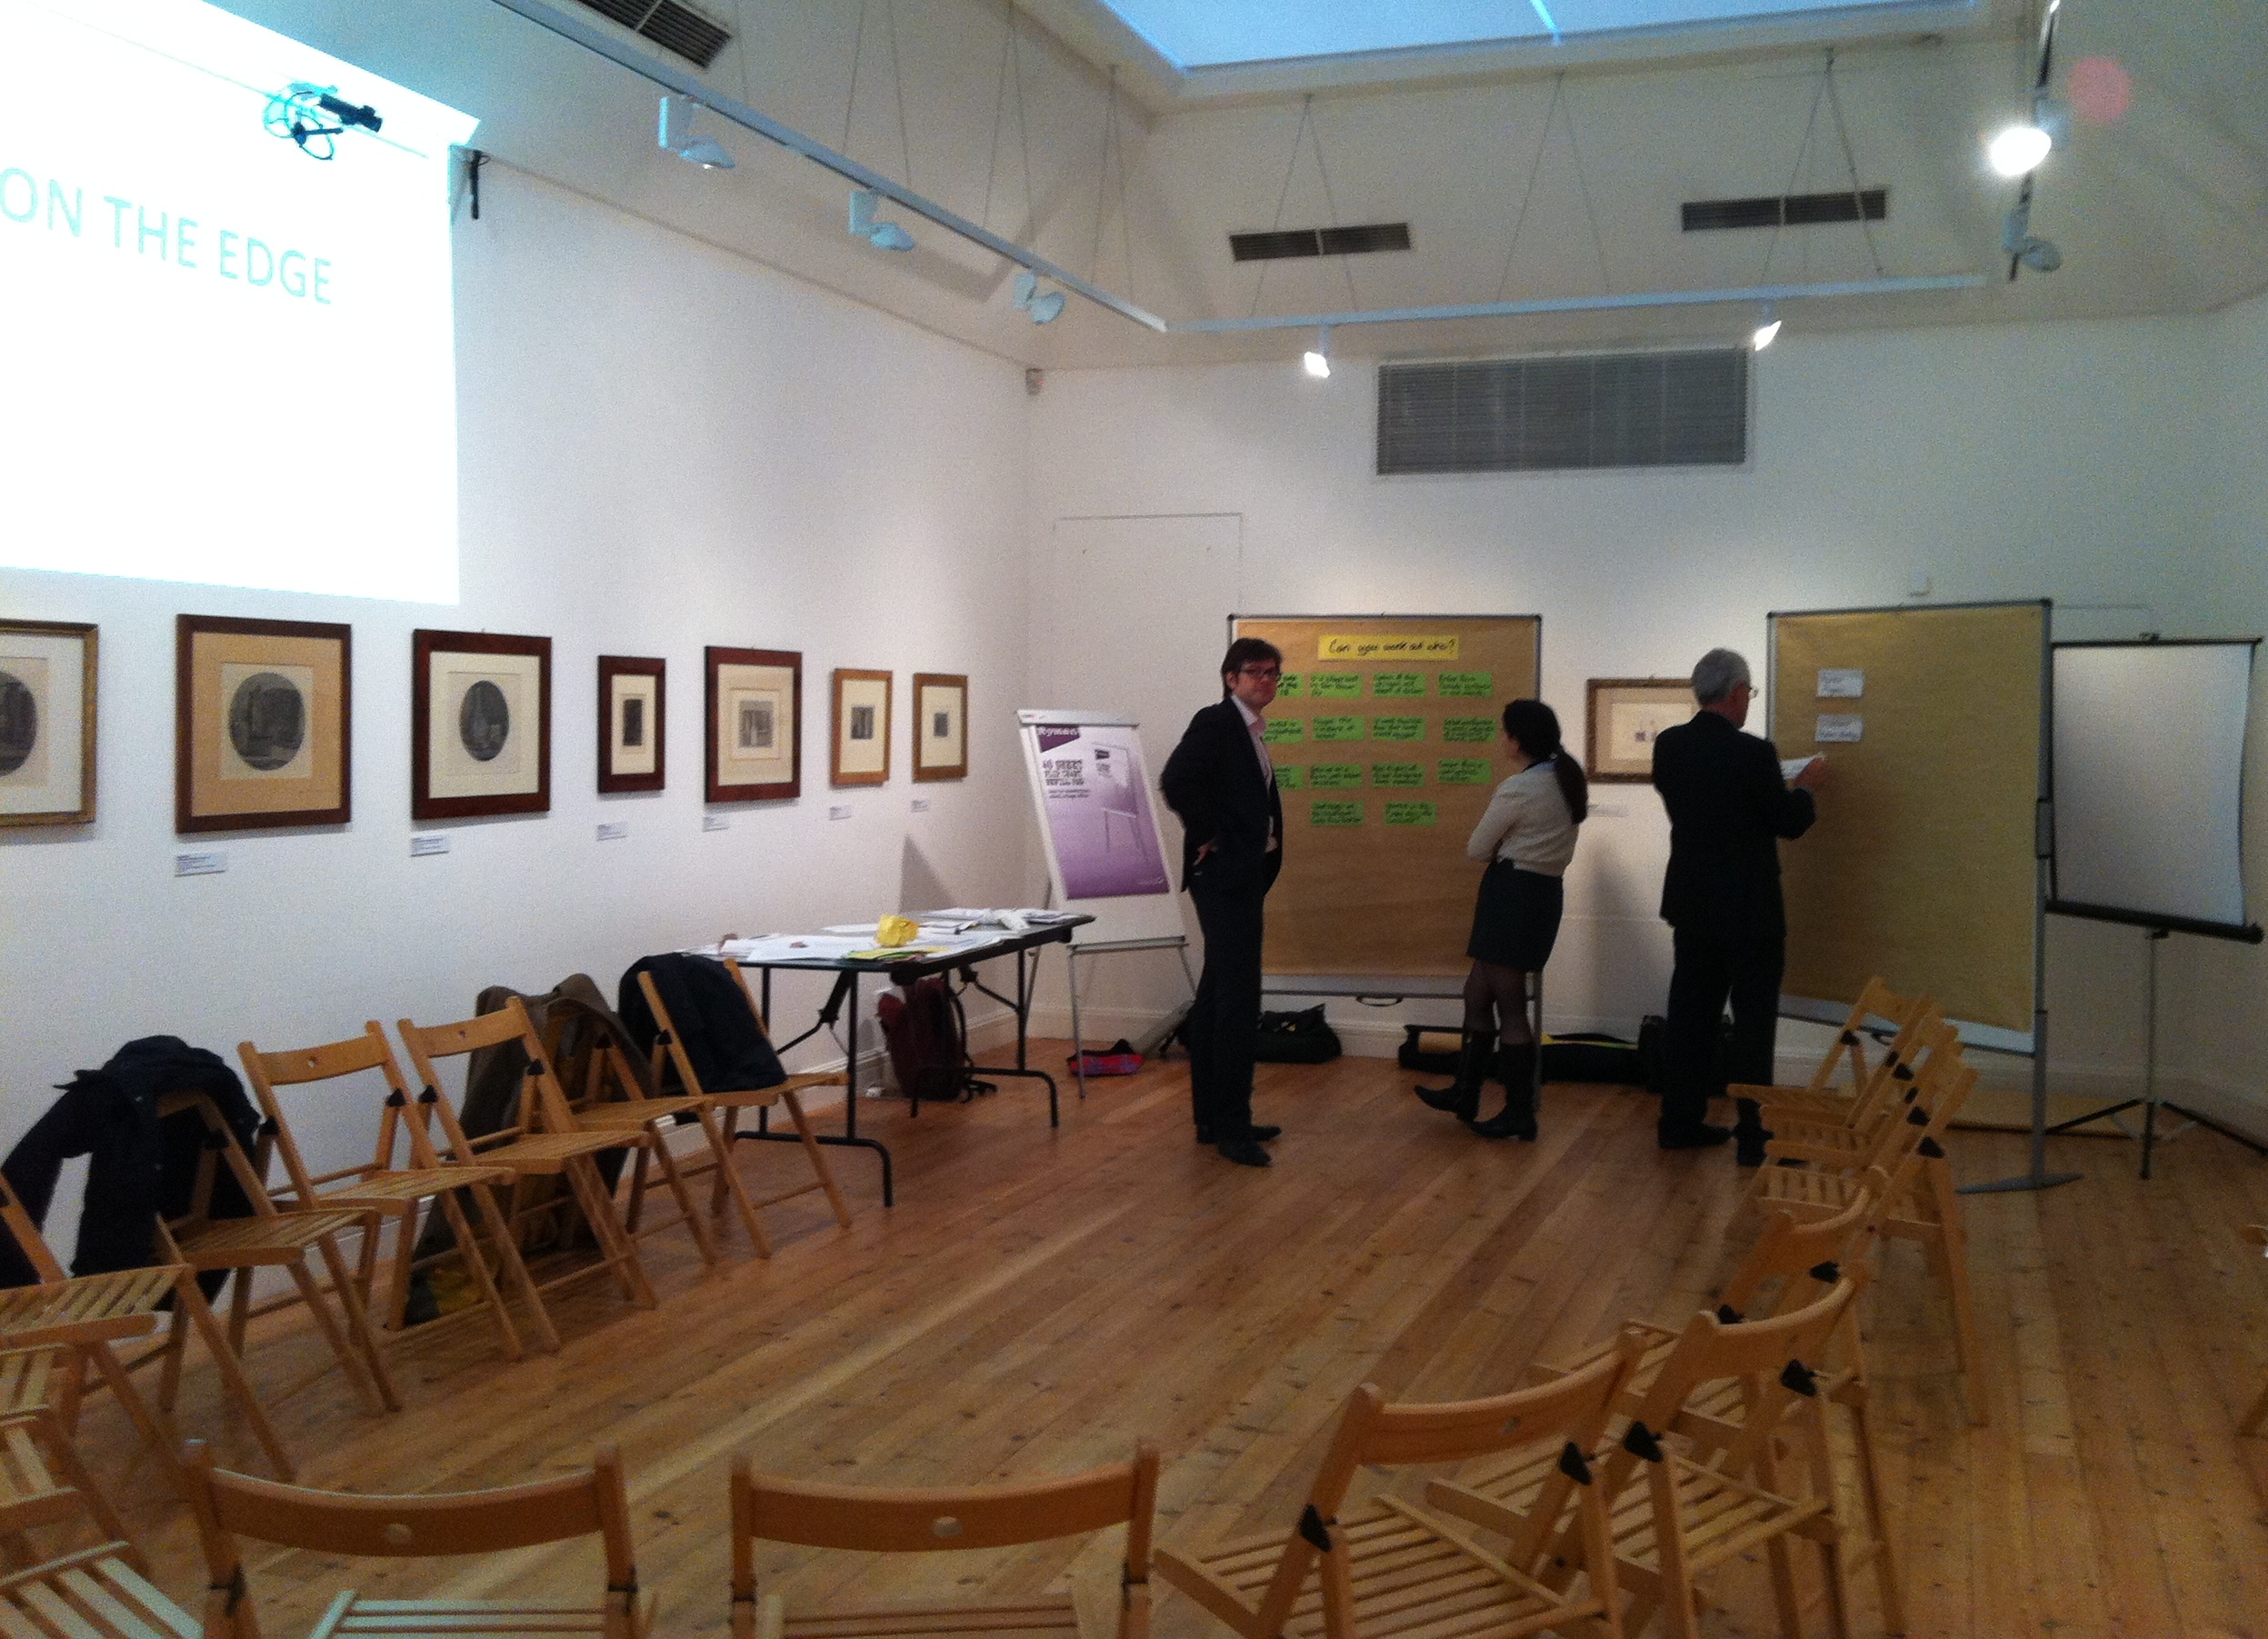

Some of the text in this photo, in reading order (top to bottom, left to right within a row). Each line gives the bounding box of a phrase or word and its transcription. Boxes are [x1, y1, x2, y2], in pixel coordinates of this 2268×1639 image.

[0, 166, 332, 305] ON THE EDGE
[1329, 638, 1351, 654] Can
[1357, 643, 1379, 656] you
